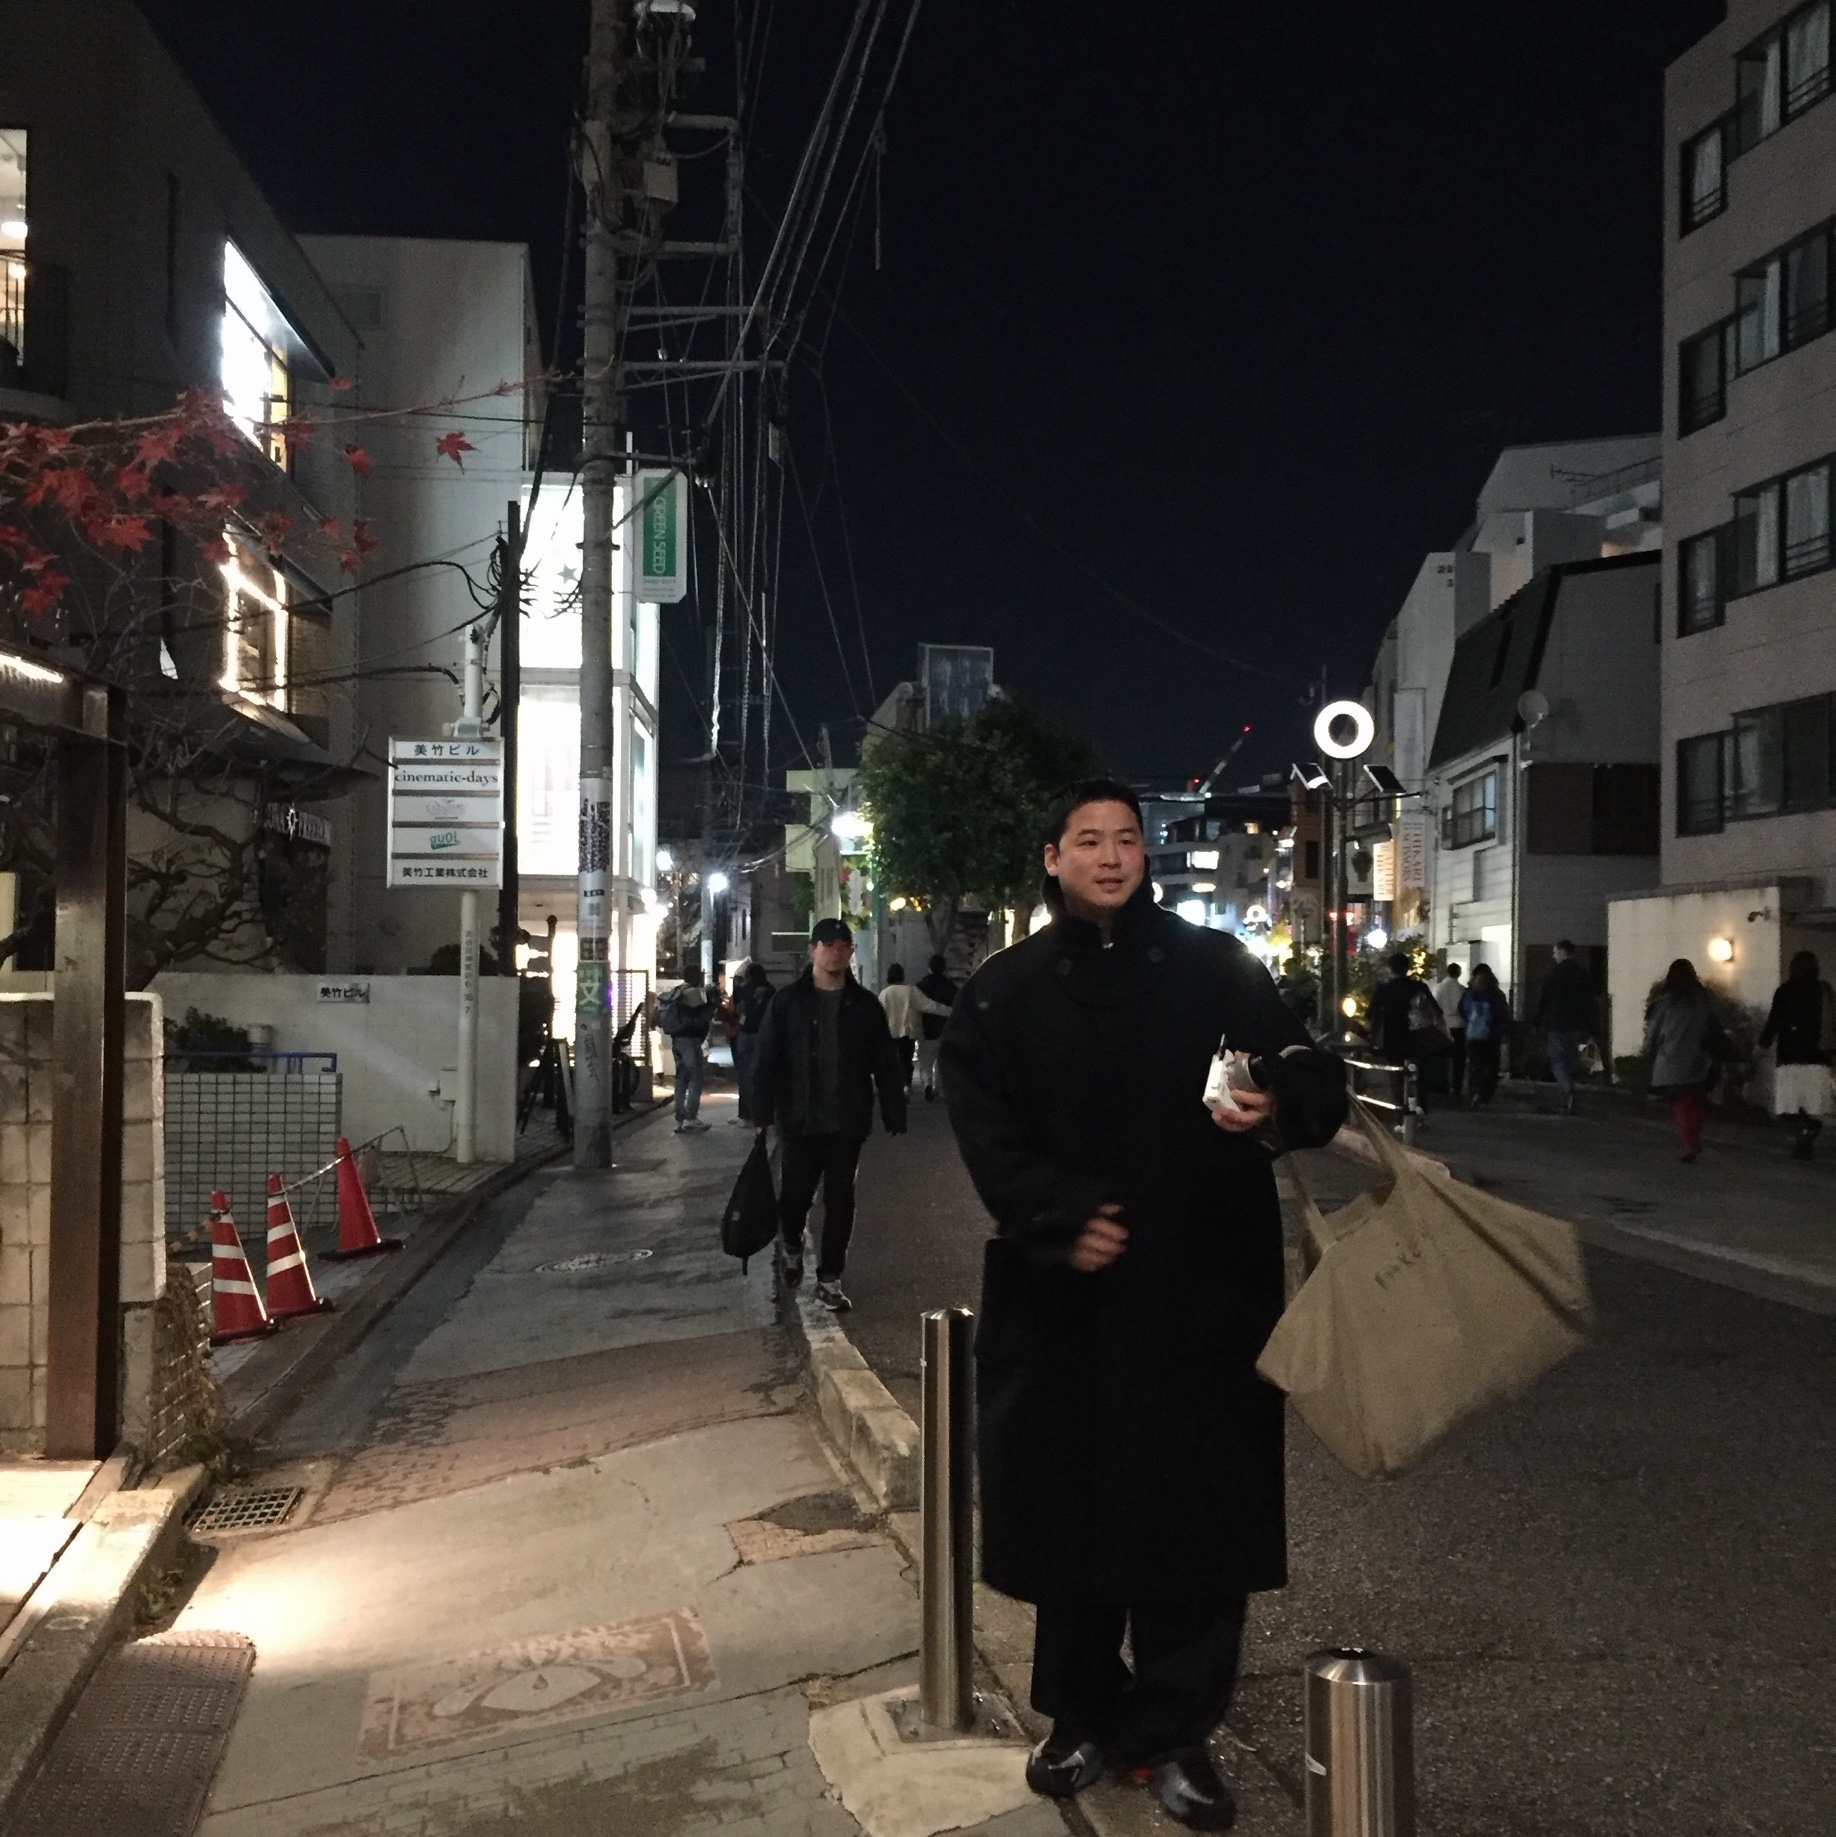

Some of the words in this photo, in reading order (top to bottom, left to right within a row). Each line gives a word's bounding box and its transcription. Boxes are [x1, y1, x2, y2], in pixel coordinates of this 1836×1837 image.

[653, 497, 666, 539] GREEN
[653, 541, 666, 574] SEED
[414, 743, 480, 756] 美竹ビル
[394, 770, 498, 786] cinematic-days
[402, 867, 488, 878] 美竹工業株式会社
[320, 987, 365, 998] 美竹ビル
